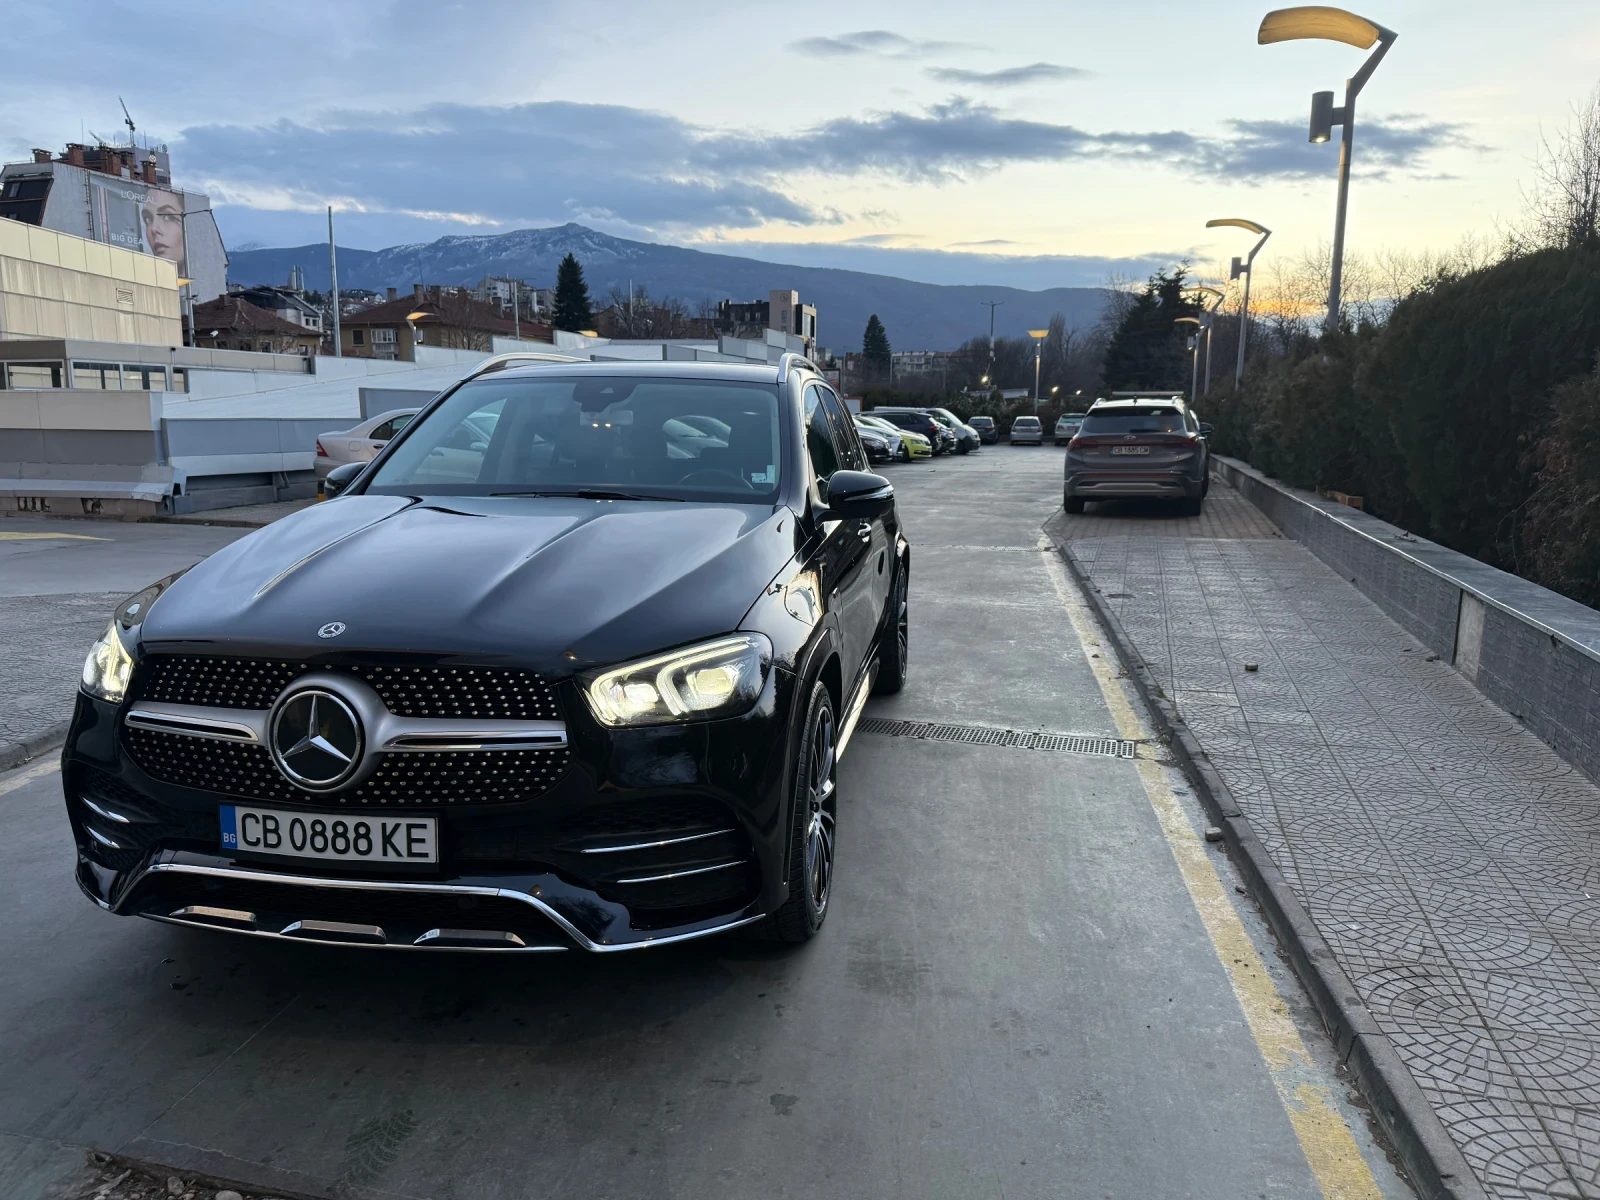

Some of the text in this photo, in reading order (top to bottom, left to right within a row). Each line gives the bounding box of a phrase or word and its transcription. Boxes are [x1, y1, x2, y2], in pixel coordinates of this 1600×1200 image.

[111, 232, 126, 243] BIG
[223, 832, 236, 843] BG
[241, 812, 430, 858] CB 0888 KE
